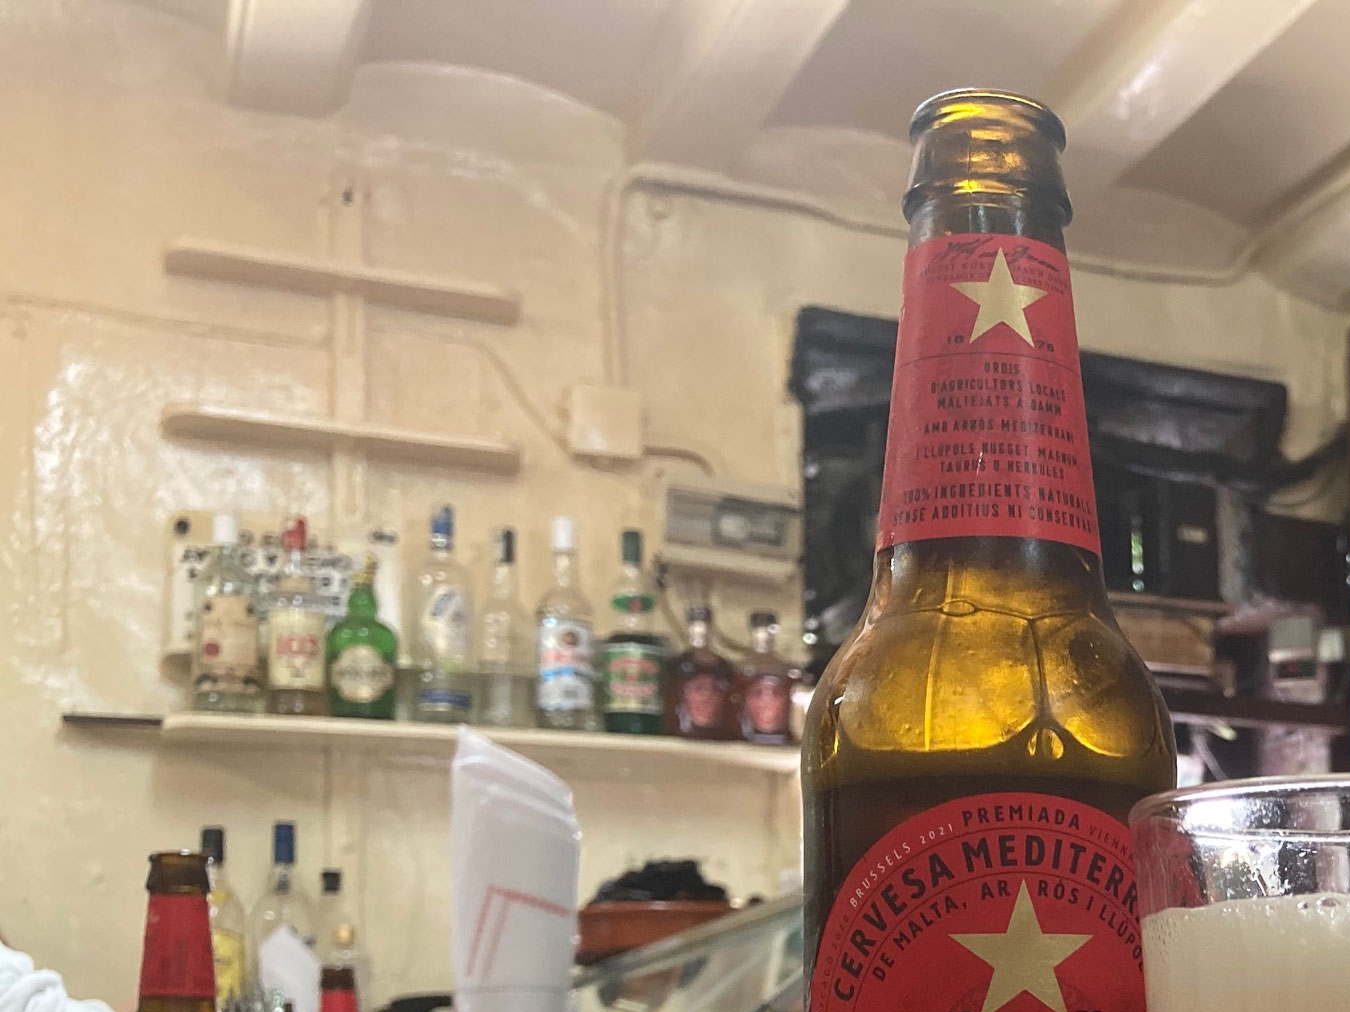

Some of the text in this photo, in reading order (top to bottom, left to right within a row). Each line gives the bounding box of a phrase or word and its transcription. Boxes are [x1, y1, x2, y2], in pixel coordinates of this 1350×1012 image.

[984, 361, 1020, 375] ORDIS
[1030, 398, 1062, 417] DAMM
[934, 482, 1031, 501] INGREDIENTS
[931, 502, 1000, 520] ADDITIUS
[1007, 503, 1022, 519] NI
[962, 804, 1081, 831] PREMIADA
[849, 823, 955, 908] BRUSSELS 2021
[833, 852, 955, 1002] CERVESA
[961, 834, 1140, 923] MEDITERR
[872, 952, 896, 983] DE
[892, 895, 968, 952] MALTA,
[1085, 895, 1095, 912] I
